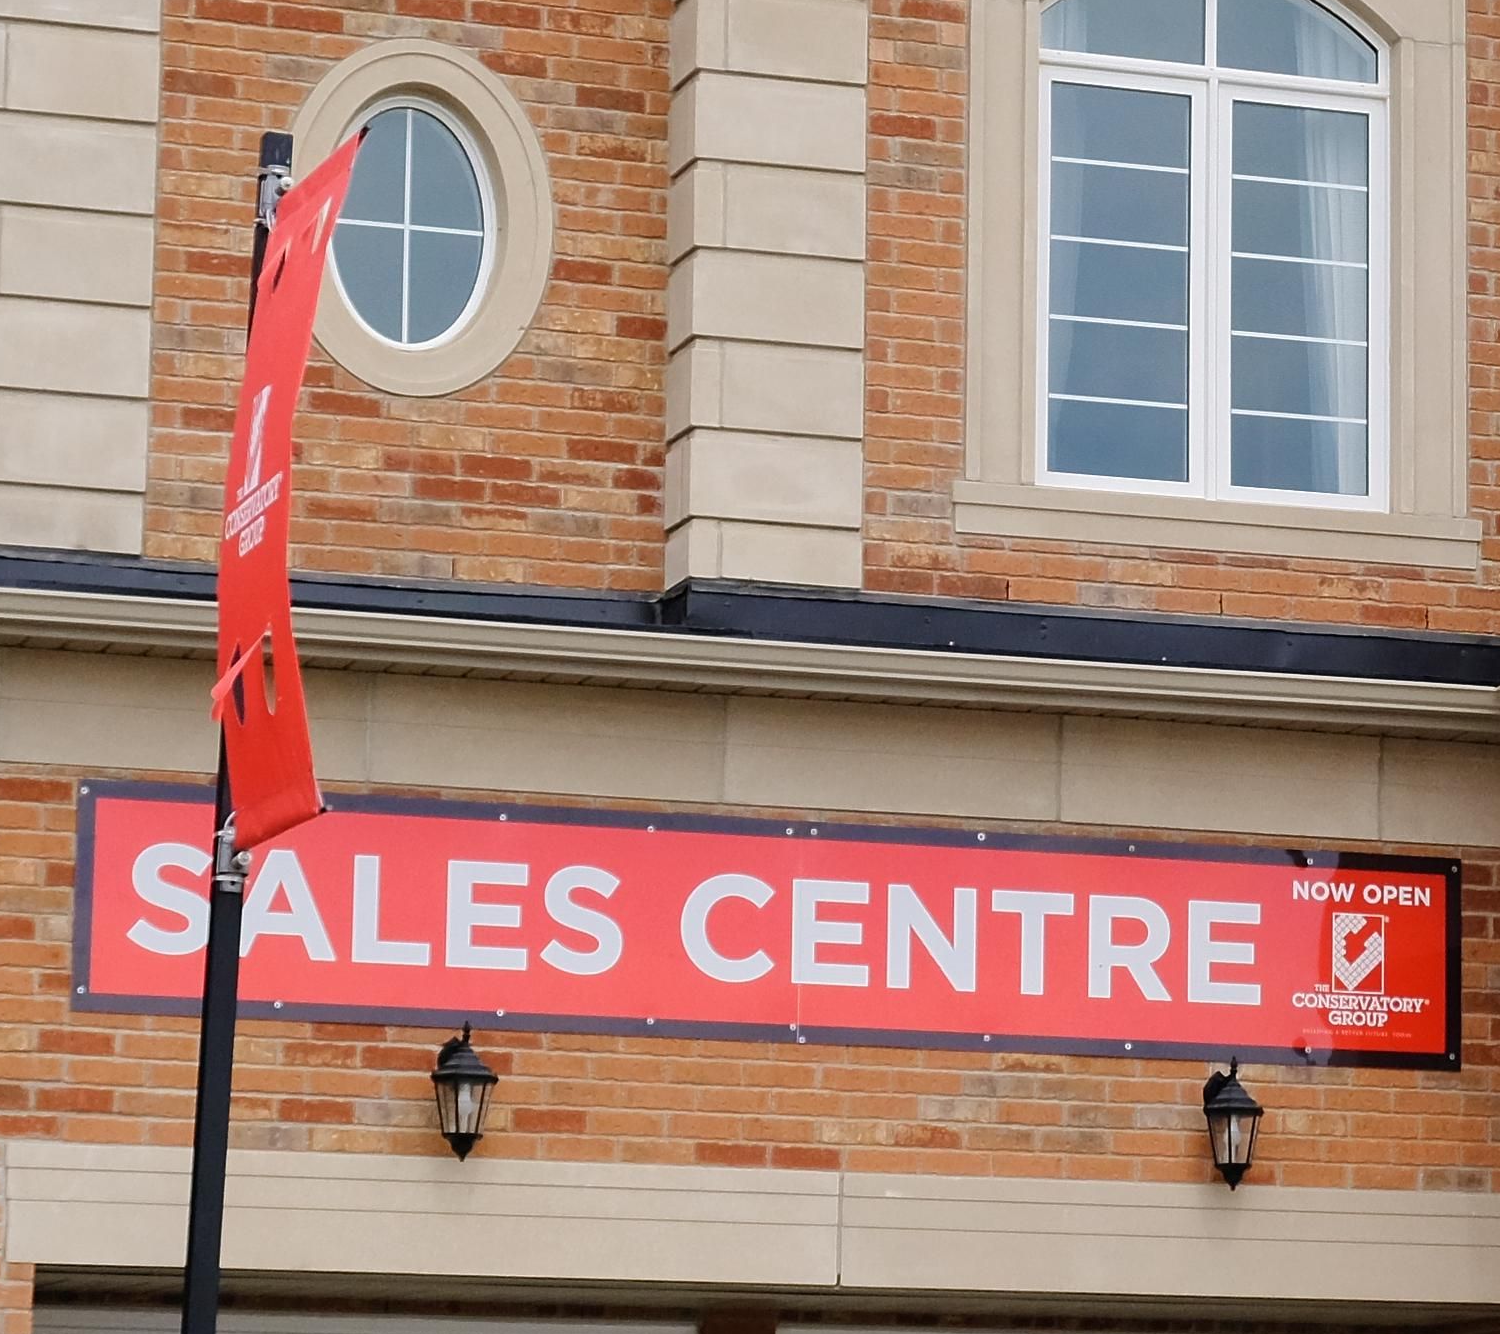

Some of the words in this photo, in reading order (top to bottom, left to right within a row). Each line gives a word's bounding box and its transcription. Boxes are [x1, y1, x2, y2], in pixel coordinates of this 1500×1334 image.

[1292, 880, 1355, 903] NOW
[1363, 884, 1430, 907] OPEN
[126, 842, 623, 975] SALES
[680, 873, 1261, 1006] CENTRE
[1314, 983, 1330, 993] THE
[1292, 993, 1425, 1013] CONSERVATORY
[1328, 1011, 1388, 1027] GROUP
